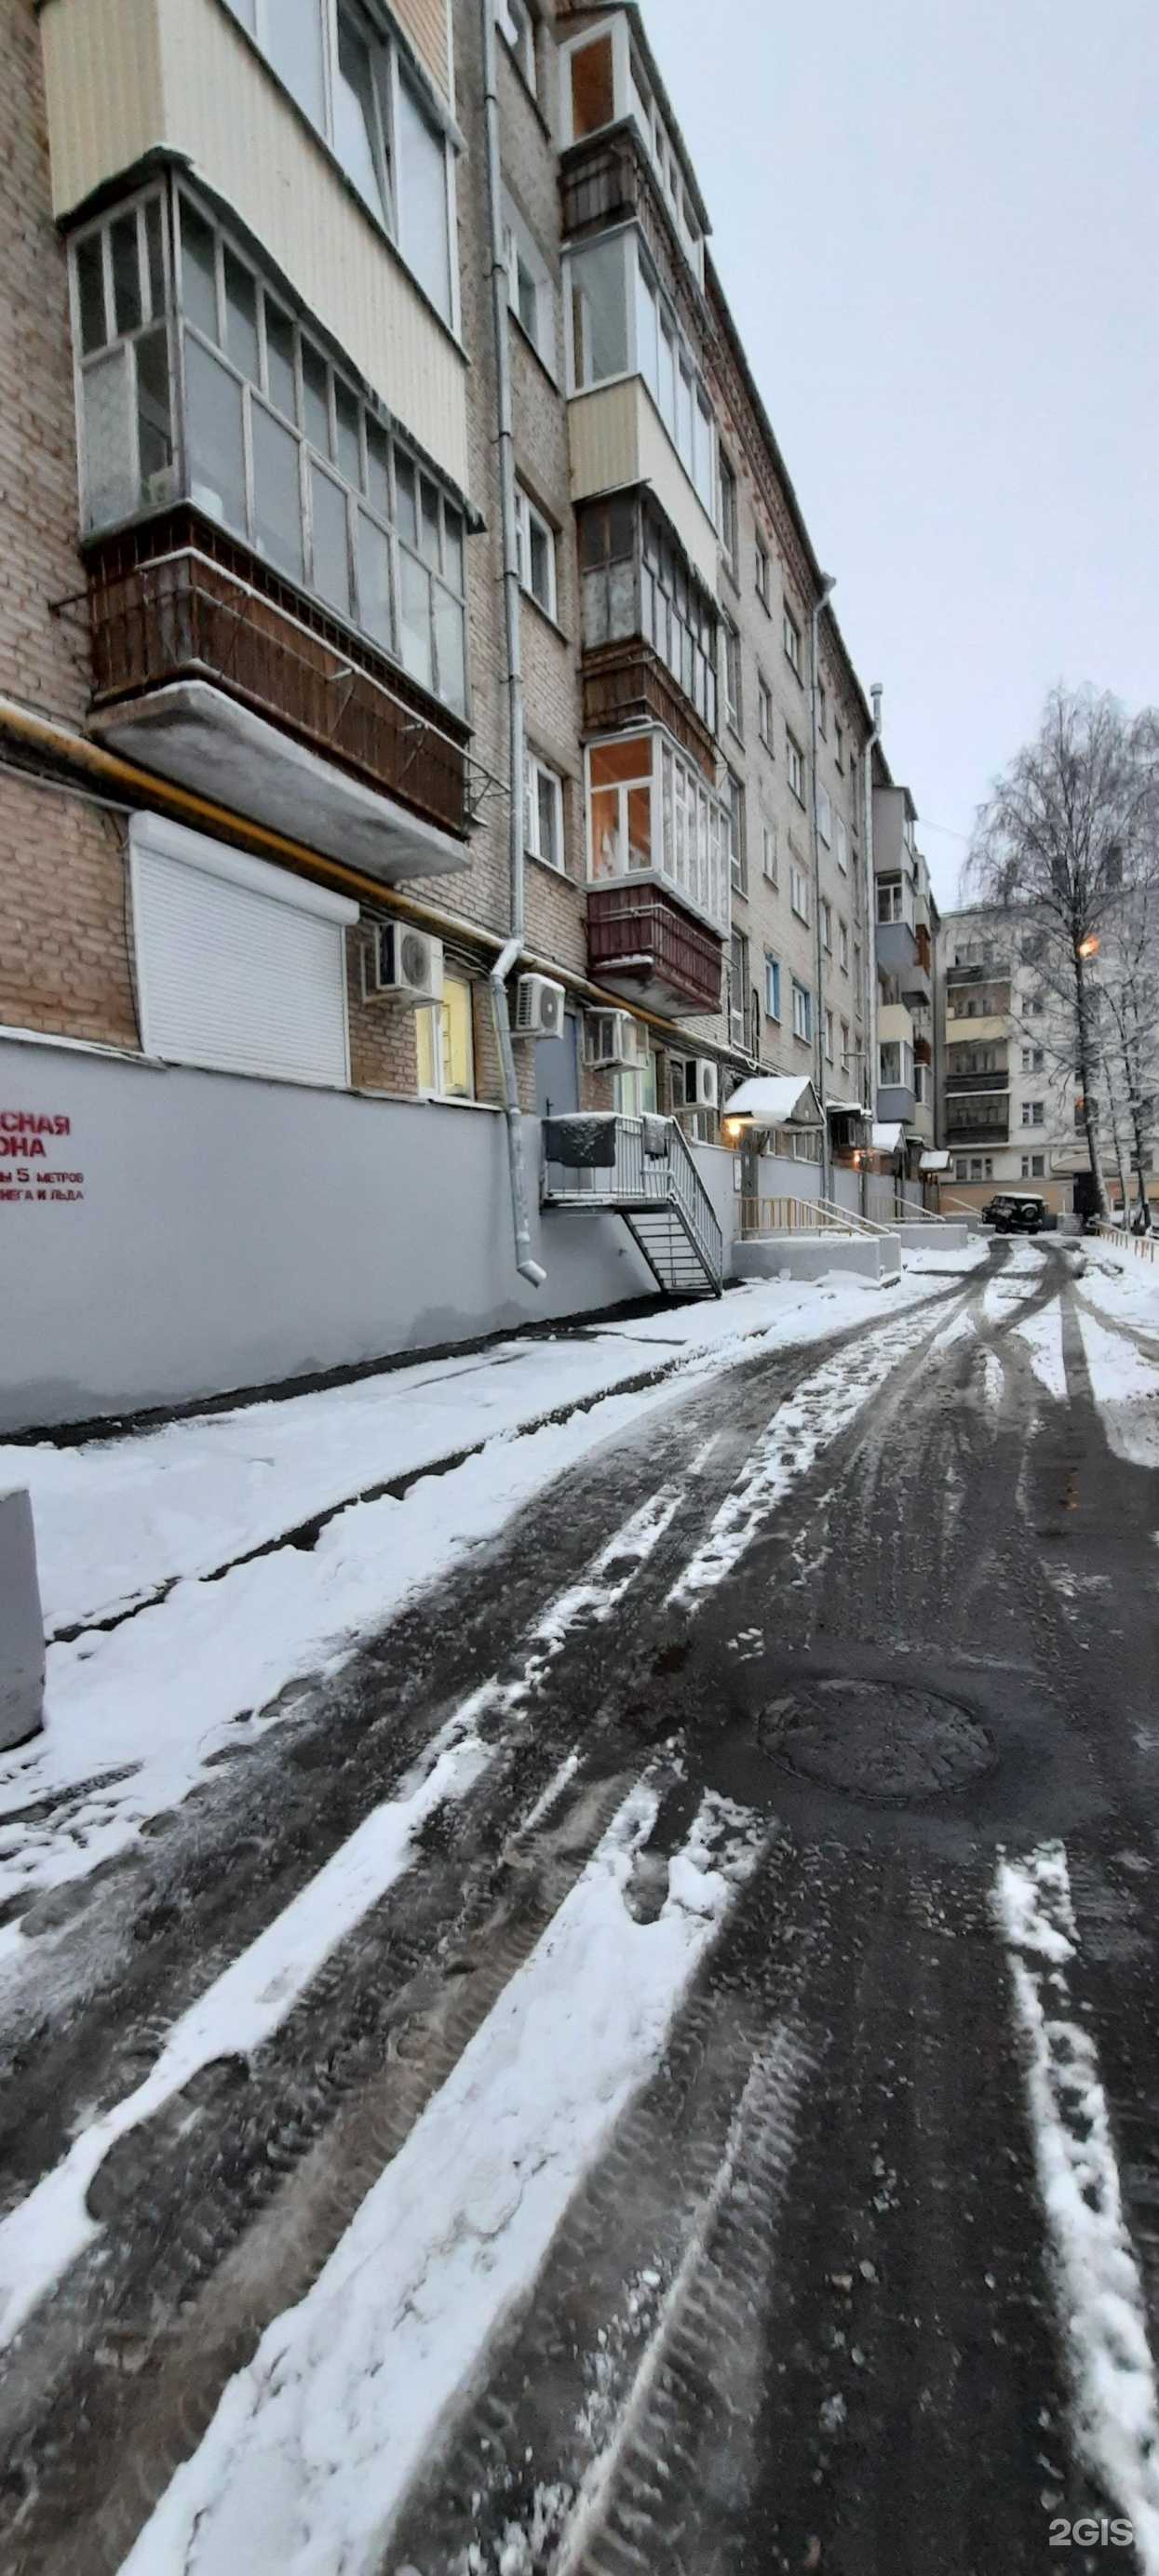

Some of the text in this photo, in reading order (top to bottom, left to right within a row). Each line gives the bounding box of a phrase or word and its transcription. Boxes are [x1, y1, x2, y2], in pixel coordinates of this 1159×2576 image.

[17, 1168, 30, 1183] 5
[36, 1172, 84, 1184] МЕТРОВ
[37, 1189, 47, 1201] И
[50, 1189, 84, 1201] ЛЬДА
